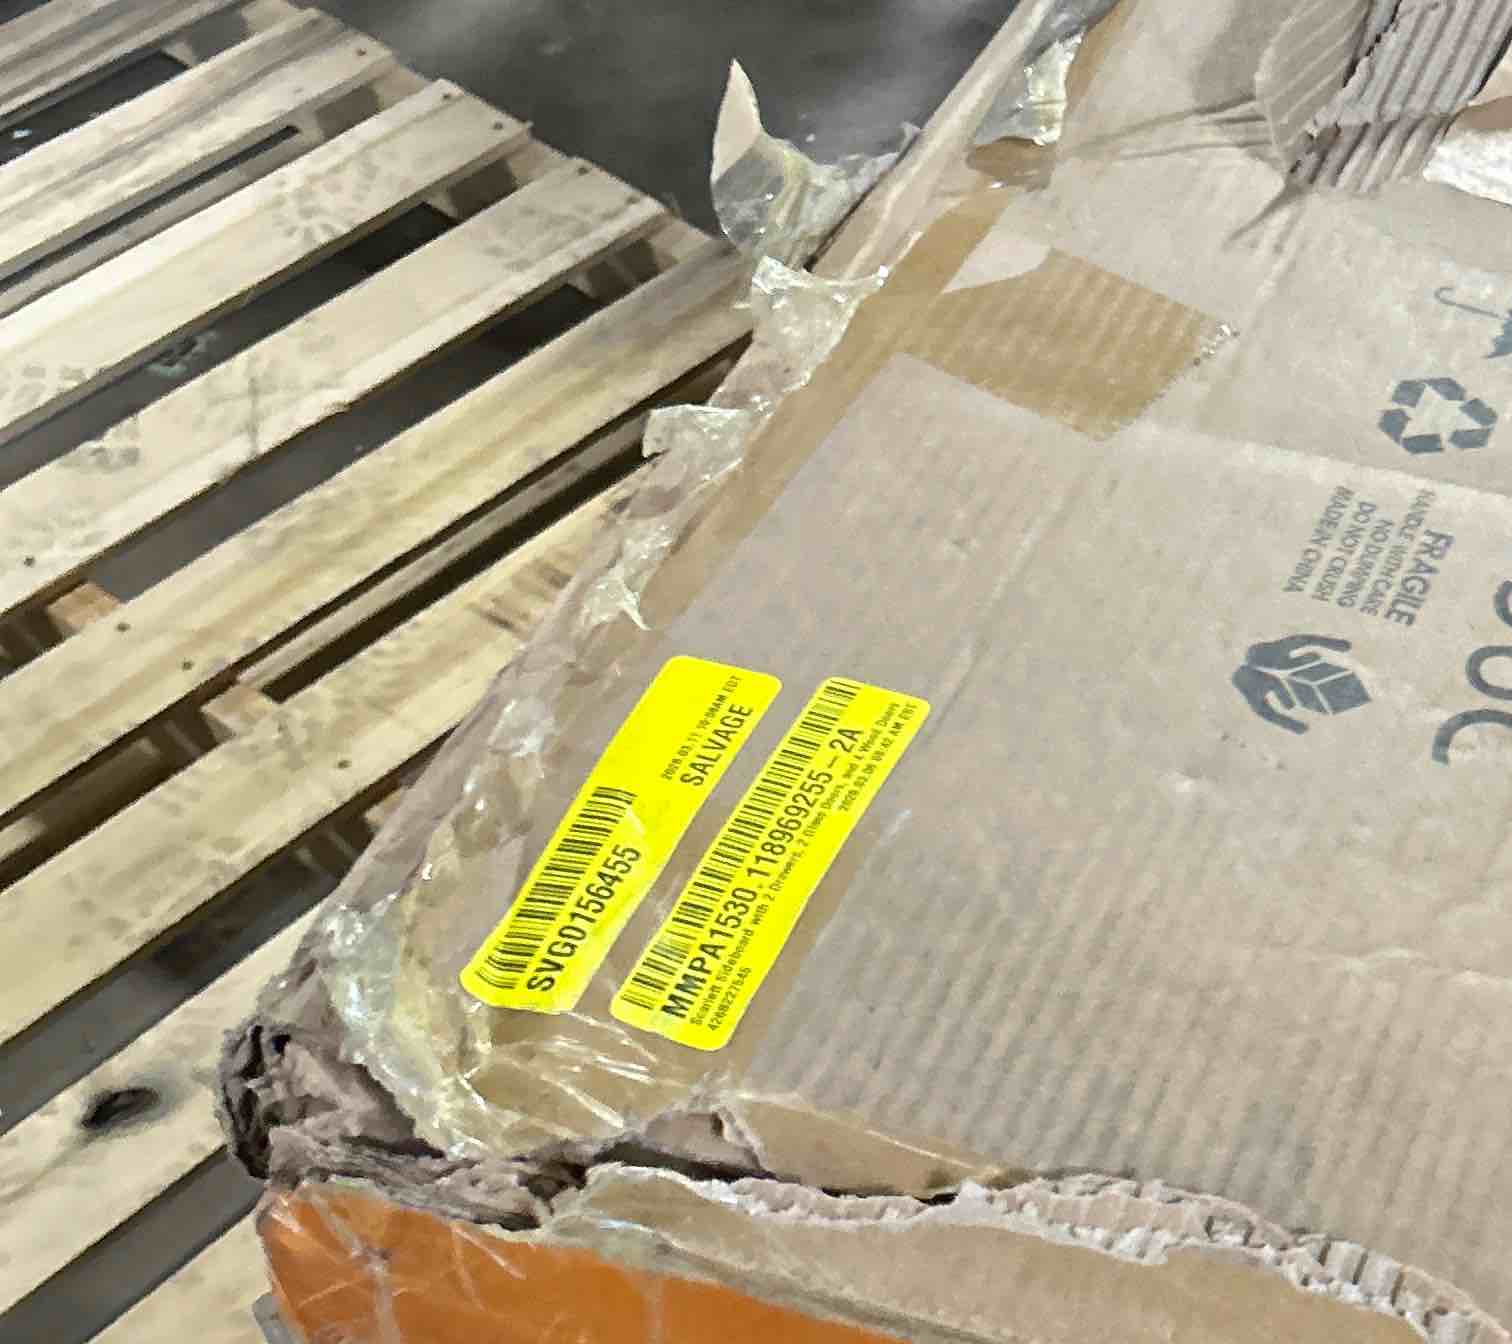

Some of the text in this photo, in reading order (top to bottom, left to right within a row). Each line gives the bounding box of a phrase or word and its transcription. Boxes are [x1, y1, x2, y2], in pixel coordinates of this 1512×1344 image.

[1320, 486, 1355, 529] MADE
[1371, 519, 1395, 543] NO
[1282, 548, 1323, 592] CHINA
[1311, 502, 1376, 601] DO NOT CRUSH
[1384, 529, 1454, 626] FRAGILE
[680, 701, 750, 788] SALVAGE
[521, 842, 643, 995] SVG0156455
